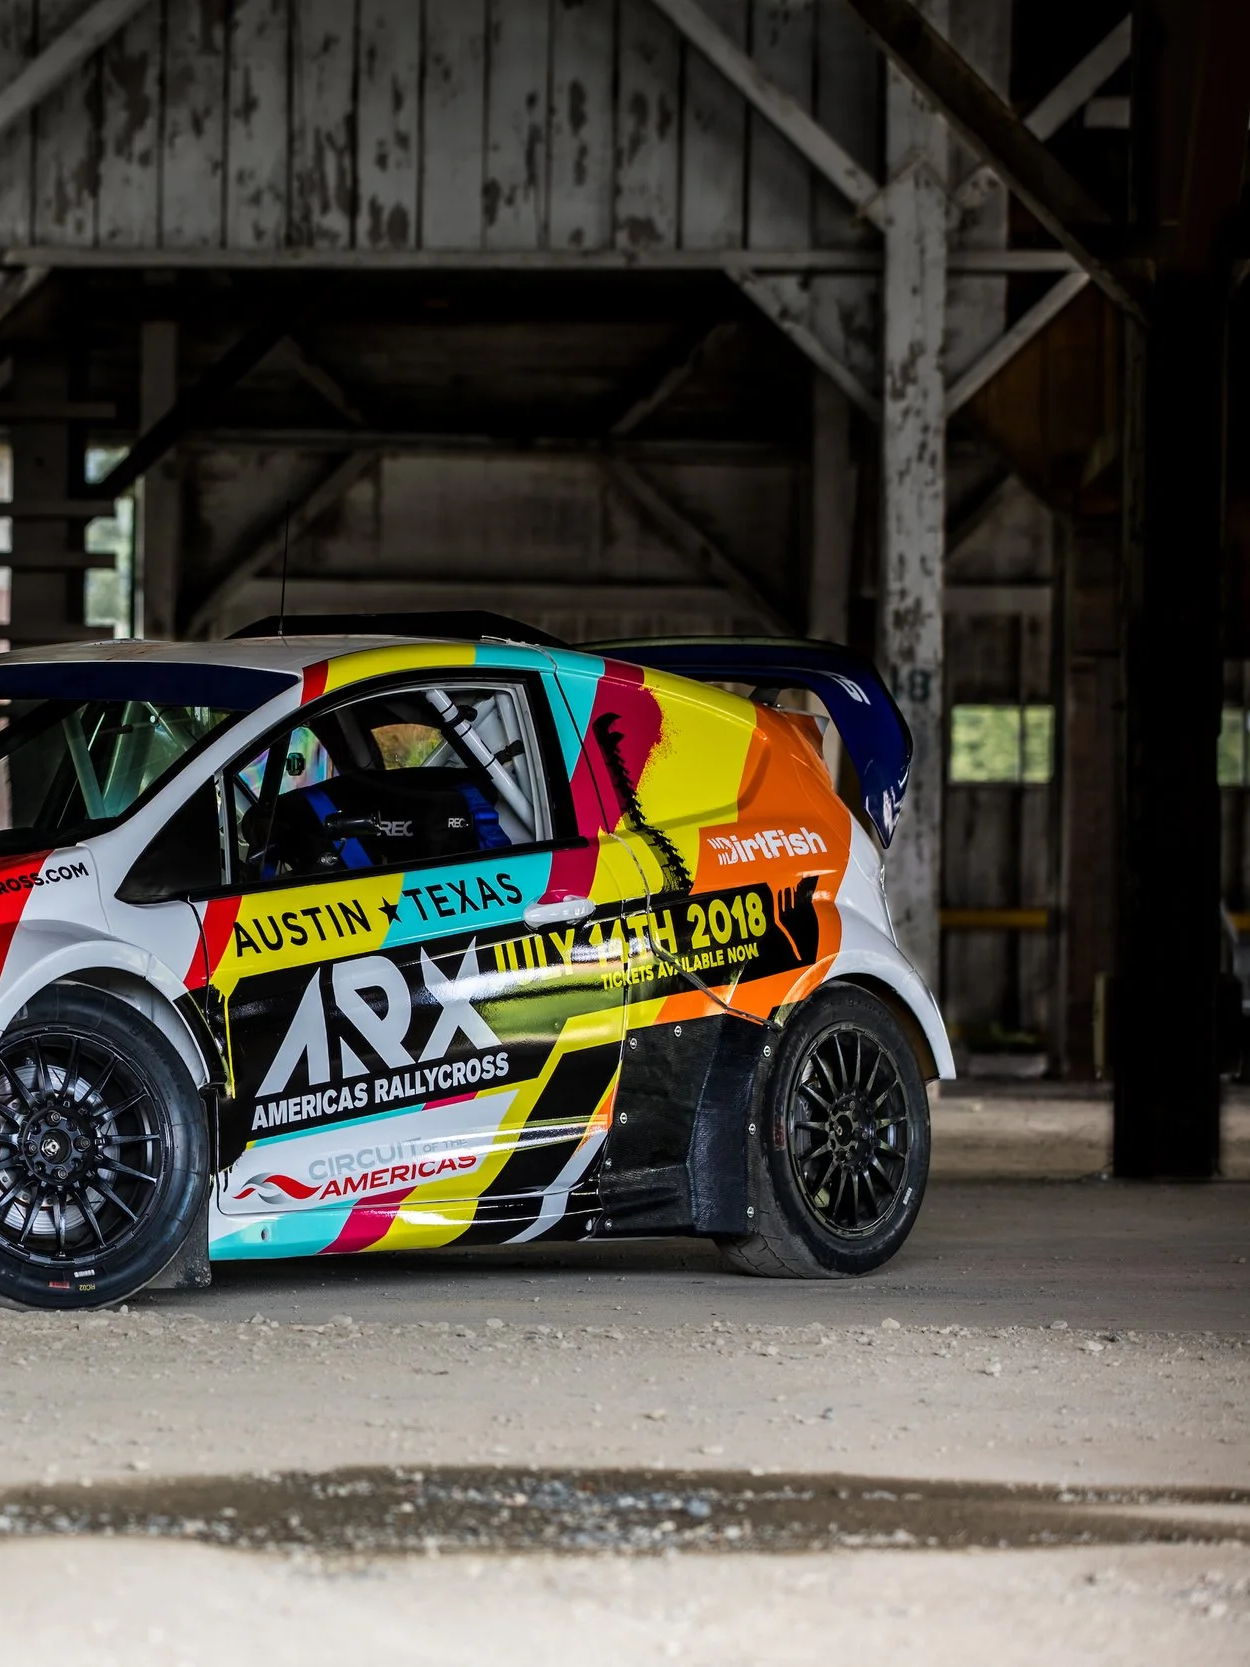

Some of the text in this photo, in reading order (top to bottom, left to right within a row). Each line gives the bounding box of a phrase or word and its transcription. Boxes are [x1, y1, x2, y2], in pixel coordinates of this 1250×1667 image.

[707, 827, 827, 866] DirtFish
[233, 873, 523, 958] AUSTIN TEXAS
[494, 892, 767, 985] JULY 14TH 2018
[601, 942, 760, 990] TICKETS AVAILABLE NOW
[254, 936, 502, 1097] ARX
[251, 1052, 509, 1130] AMERICAS RALLYCROSS
[308, 1137, 468, 1181] CIRCUIT OF THE
[319, 1155, 477, 1200] AMERICAS
